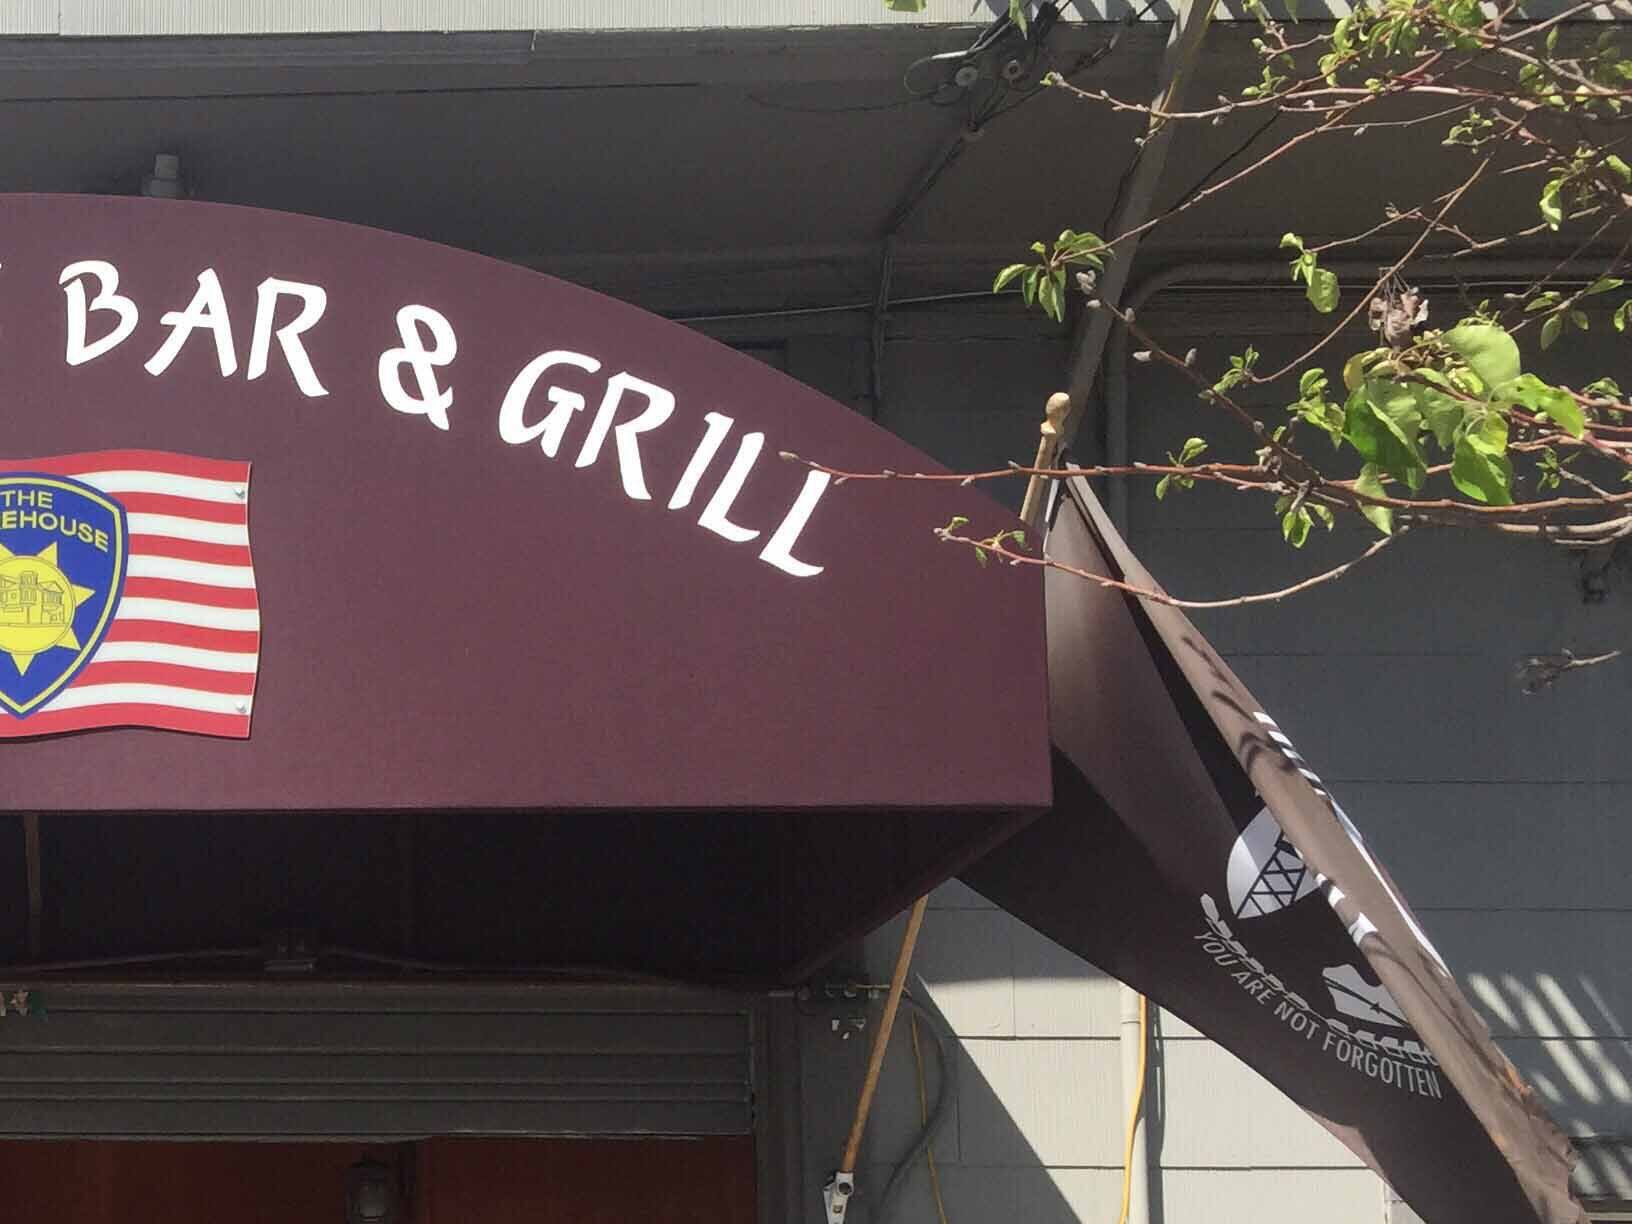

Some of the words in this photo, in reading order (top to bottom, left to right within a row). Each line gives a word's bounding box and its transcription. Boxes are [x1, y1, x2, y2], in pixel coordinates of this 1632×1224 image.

[0, 489, 53, 510] THE
[57, 259, 329, 398] BAR
[378, 303, 459, 431] &
[498, 348, 833, 577] GRILL
[1194, 930, 1239, 967] YOU
[1231, 970, 1276, 1005] ARE
[1273, 1001, 1321, 1040] NOT
[1322, 1031, 1443, 1099] FORGOTTEN
